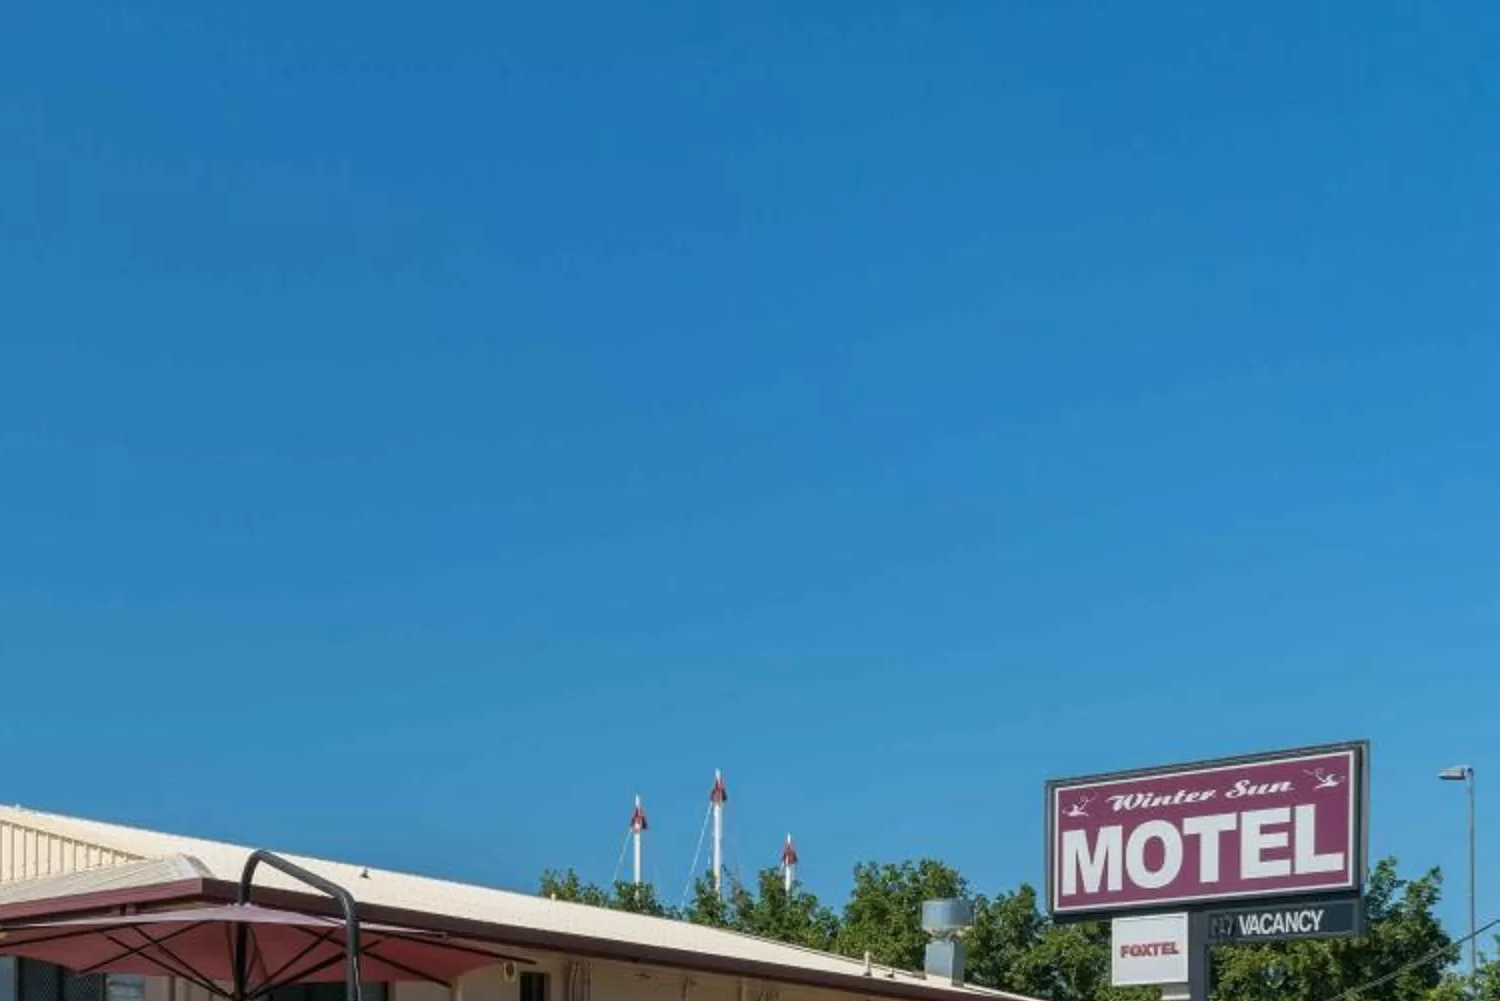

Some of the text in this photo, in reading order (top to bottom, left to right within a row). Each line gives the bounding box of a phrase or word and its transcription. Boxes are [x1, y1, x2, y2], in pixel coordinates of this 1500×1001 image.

[1105, 779, 1296, 812] Winter Sun
[1061, 803, 1344, 896] MOTEL
[1238, 909, 1324, 936] VACANCY
[1120, 941, 1180, 959] FOXTEL
